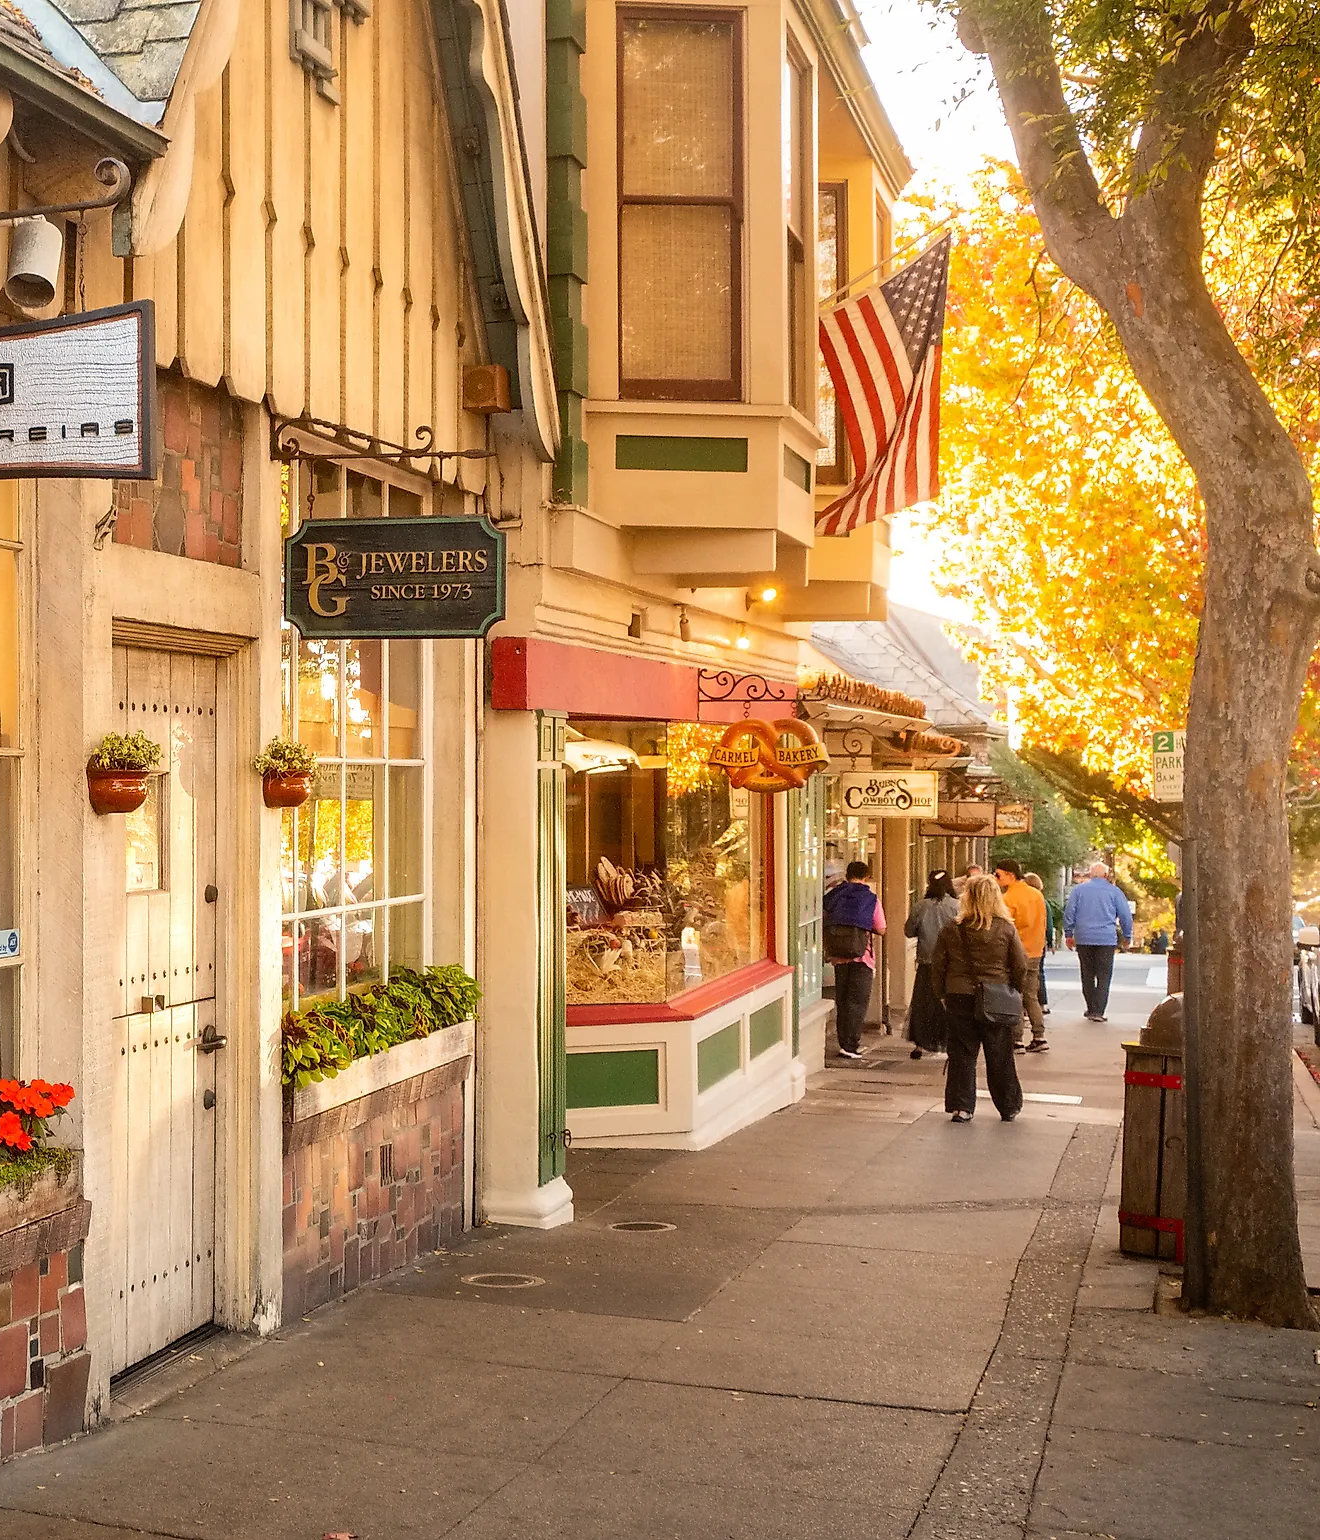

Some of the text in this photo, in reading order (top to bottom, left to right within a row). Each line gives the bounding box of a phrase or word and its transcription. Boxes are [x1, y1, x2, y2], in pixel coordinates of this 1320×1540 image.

[356, 549, 488, 580] JEWELERS
[370, 583, 473, 600] SINCE 1973
[1157, 735, 1170, 750] 2
[714, 746, 820, 764] CARMEL BAKERY
[844, 786, 896, 810] COWBOY
